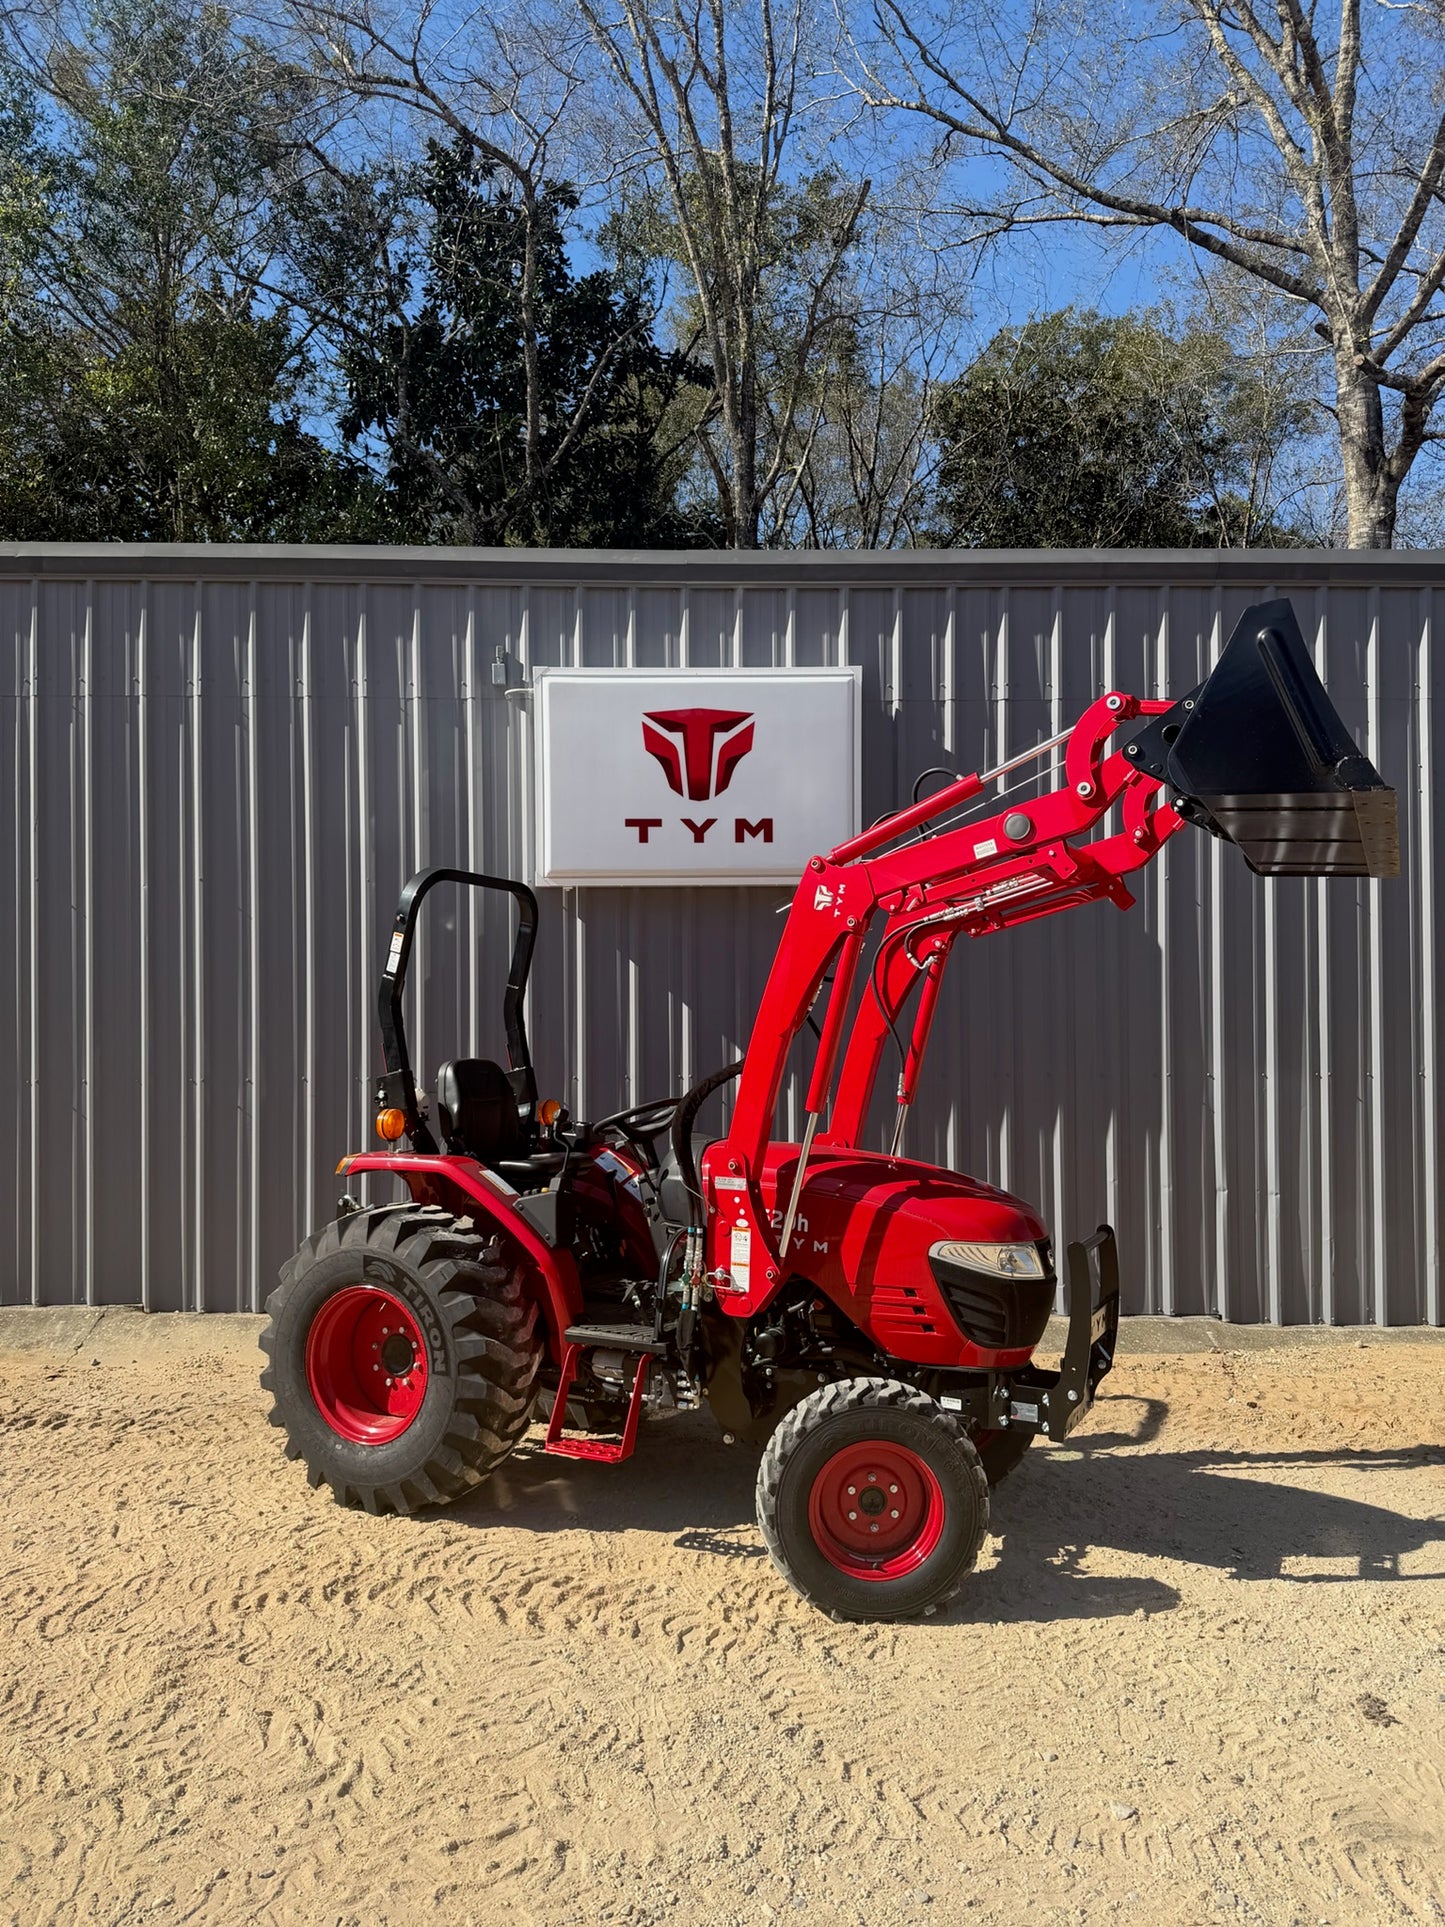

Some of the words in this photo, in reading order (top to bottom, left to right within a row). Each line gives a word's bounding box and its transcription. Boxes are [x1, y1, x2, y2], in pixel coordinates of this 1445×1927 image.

[624, 818, 774, 843] TYM
[833, 884, 846, 918] TYM
[765, 1208, 809, 1233] 2h
[400, 1276, 446, 1372] TIRON
